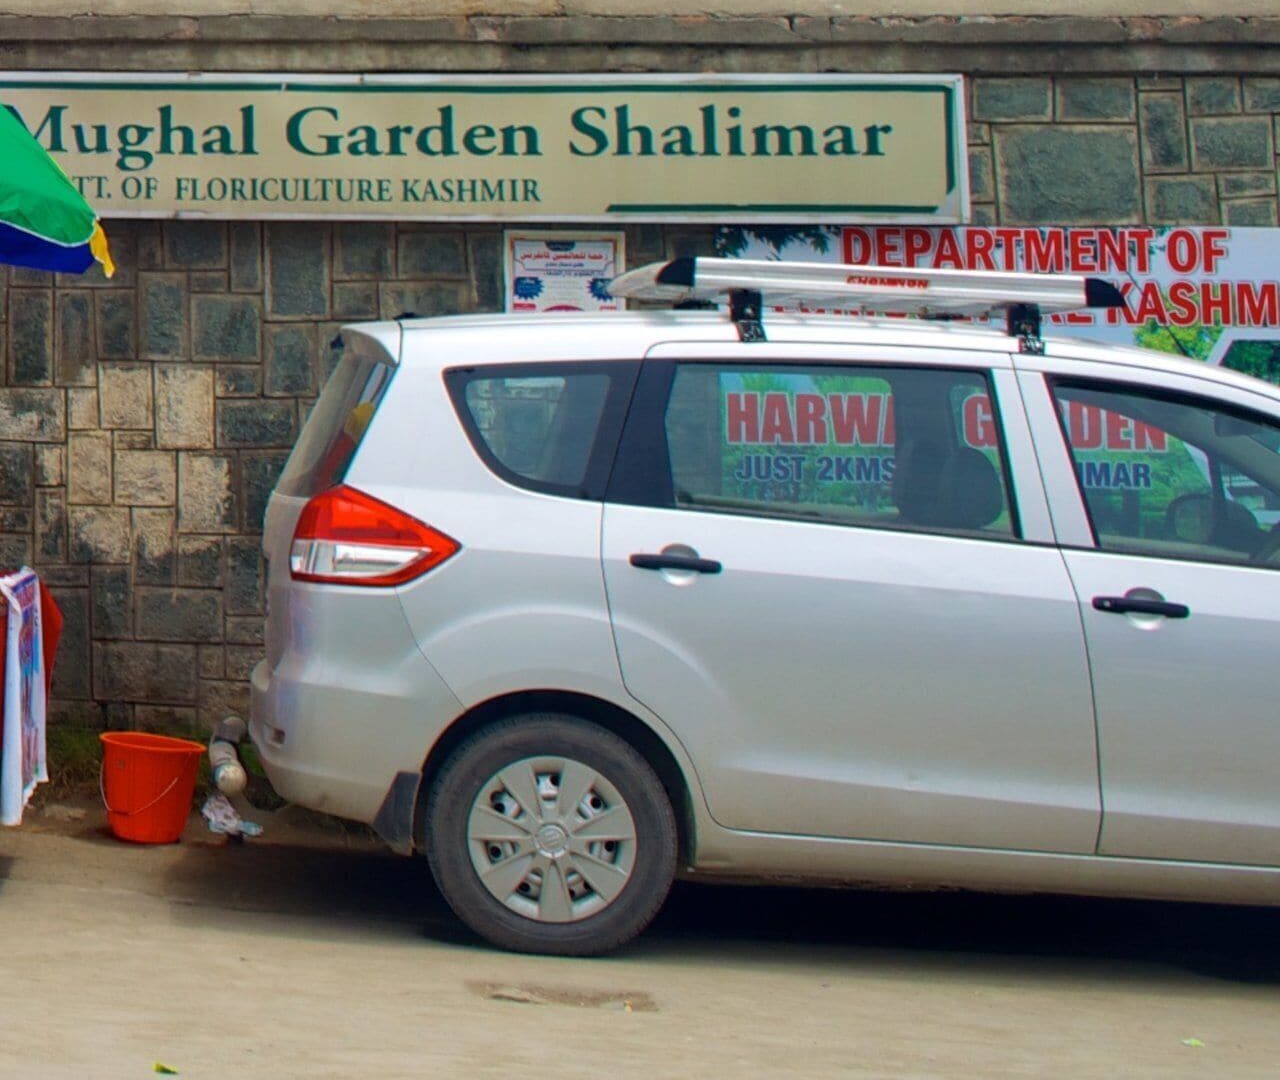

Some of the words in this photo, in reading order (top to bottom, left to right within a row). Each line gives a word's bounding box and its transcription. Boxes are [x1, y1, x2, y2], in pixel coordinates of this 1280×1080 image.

[2, 104, 259, 172] Mughal
[286, 104, 543, 157] Garden
[569, 104, 893, 157] Shalimar
[121, 177, 157, 200] OF
[175, 177, 393, 202] FLORICULTURE
[402, 178, 542, 203] KASHMIR
[842, 227, 1154, 275] DEPARTMENT
[1167, 229, 1229, 274] OF
[736, 456, 805, 483] JUST
